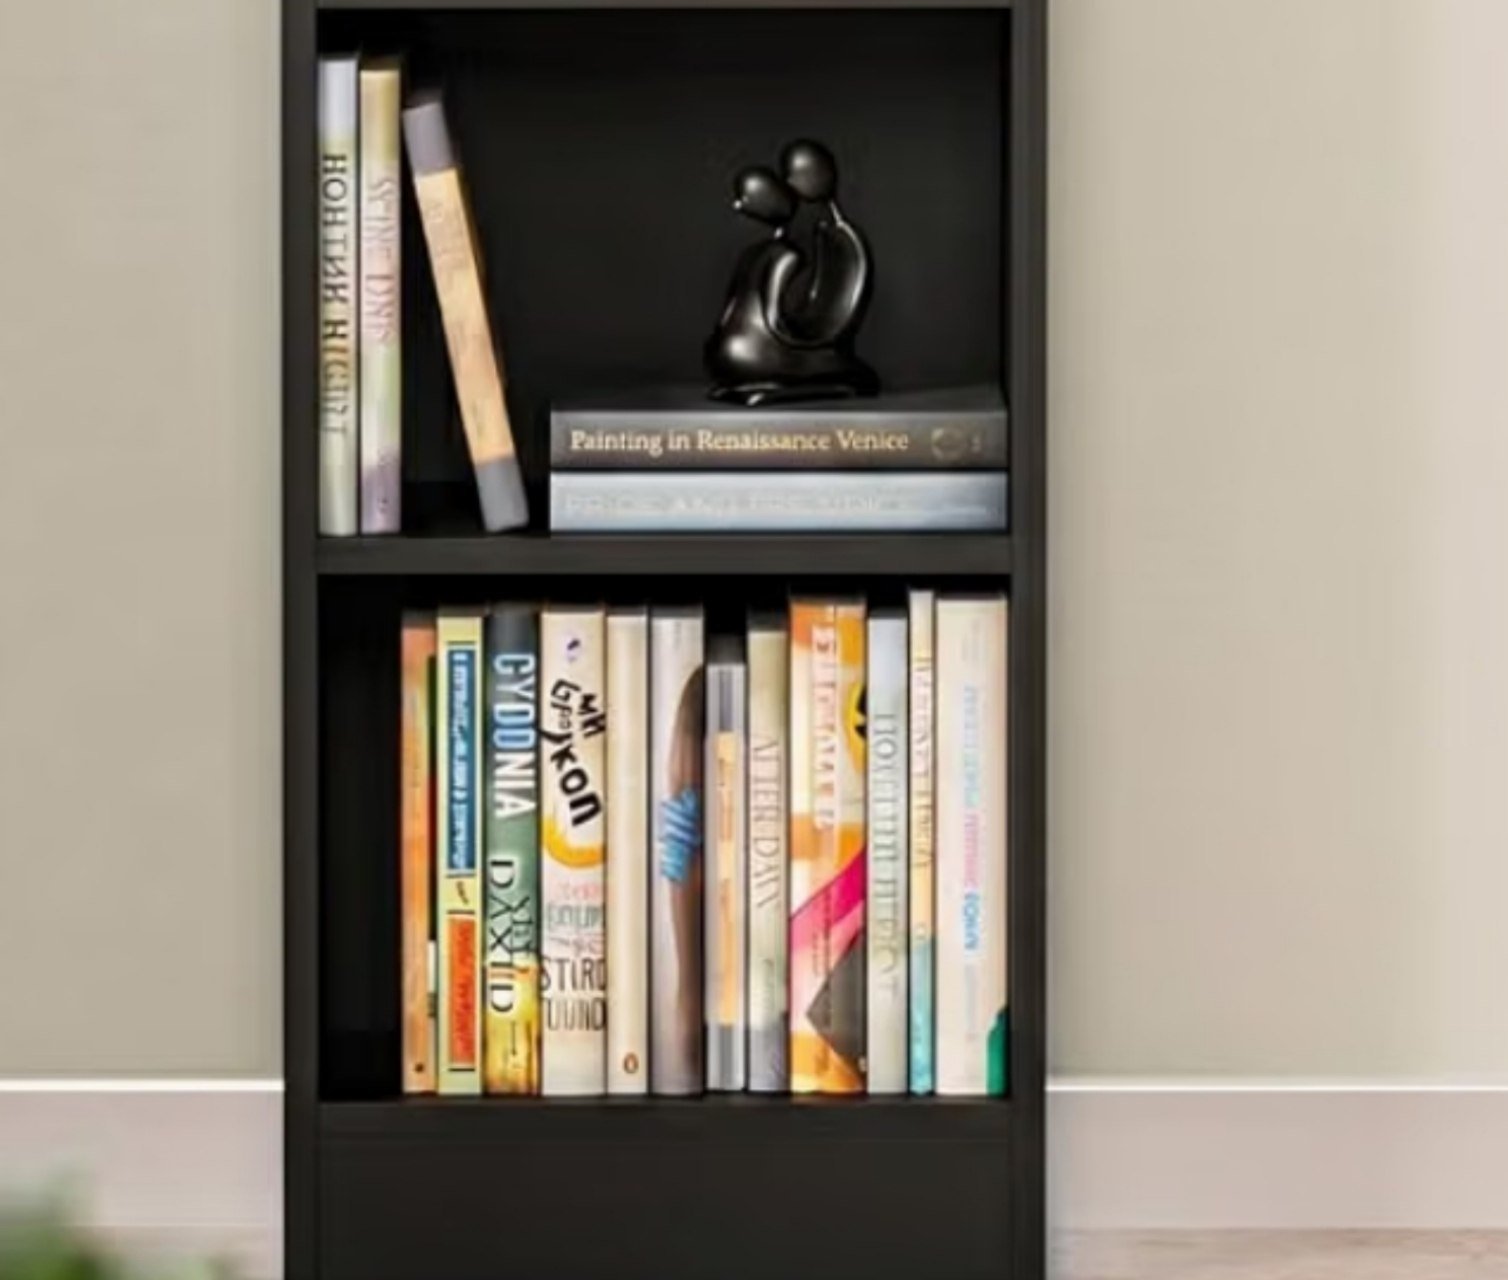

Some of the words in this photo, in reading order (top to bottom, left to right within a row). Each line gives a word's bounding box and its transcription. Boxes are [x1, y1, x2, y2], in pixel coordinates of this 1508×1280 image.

[569, 429, 664, 457] Painting
[667, 429, 691, 452] in
[696, 429, 829, 452] Renaissance
[836, 429, 911, 452] Venice
[493, 652, 538, 819] CYDONIA
